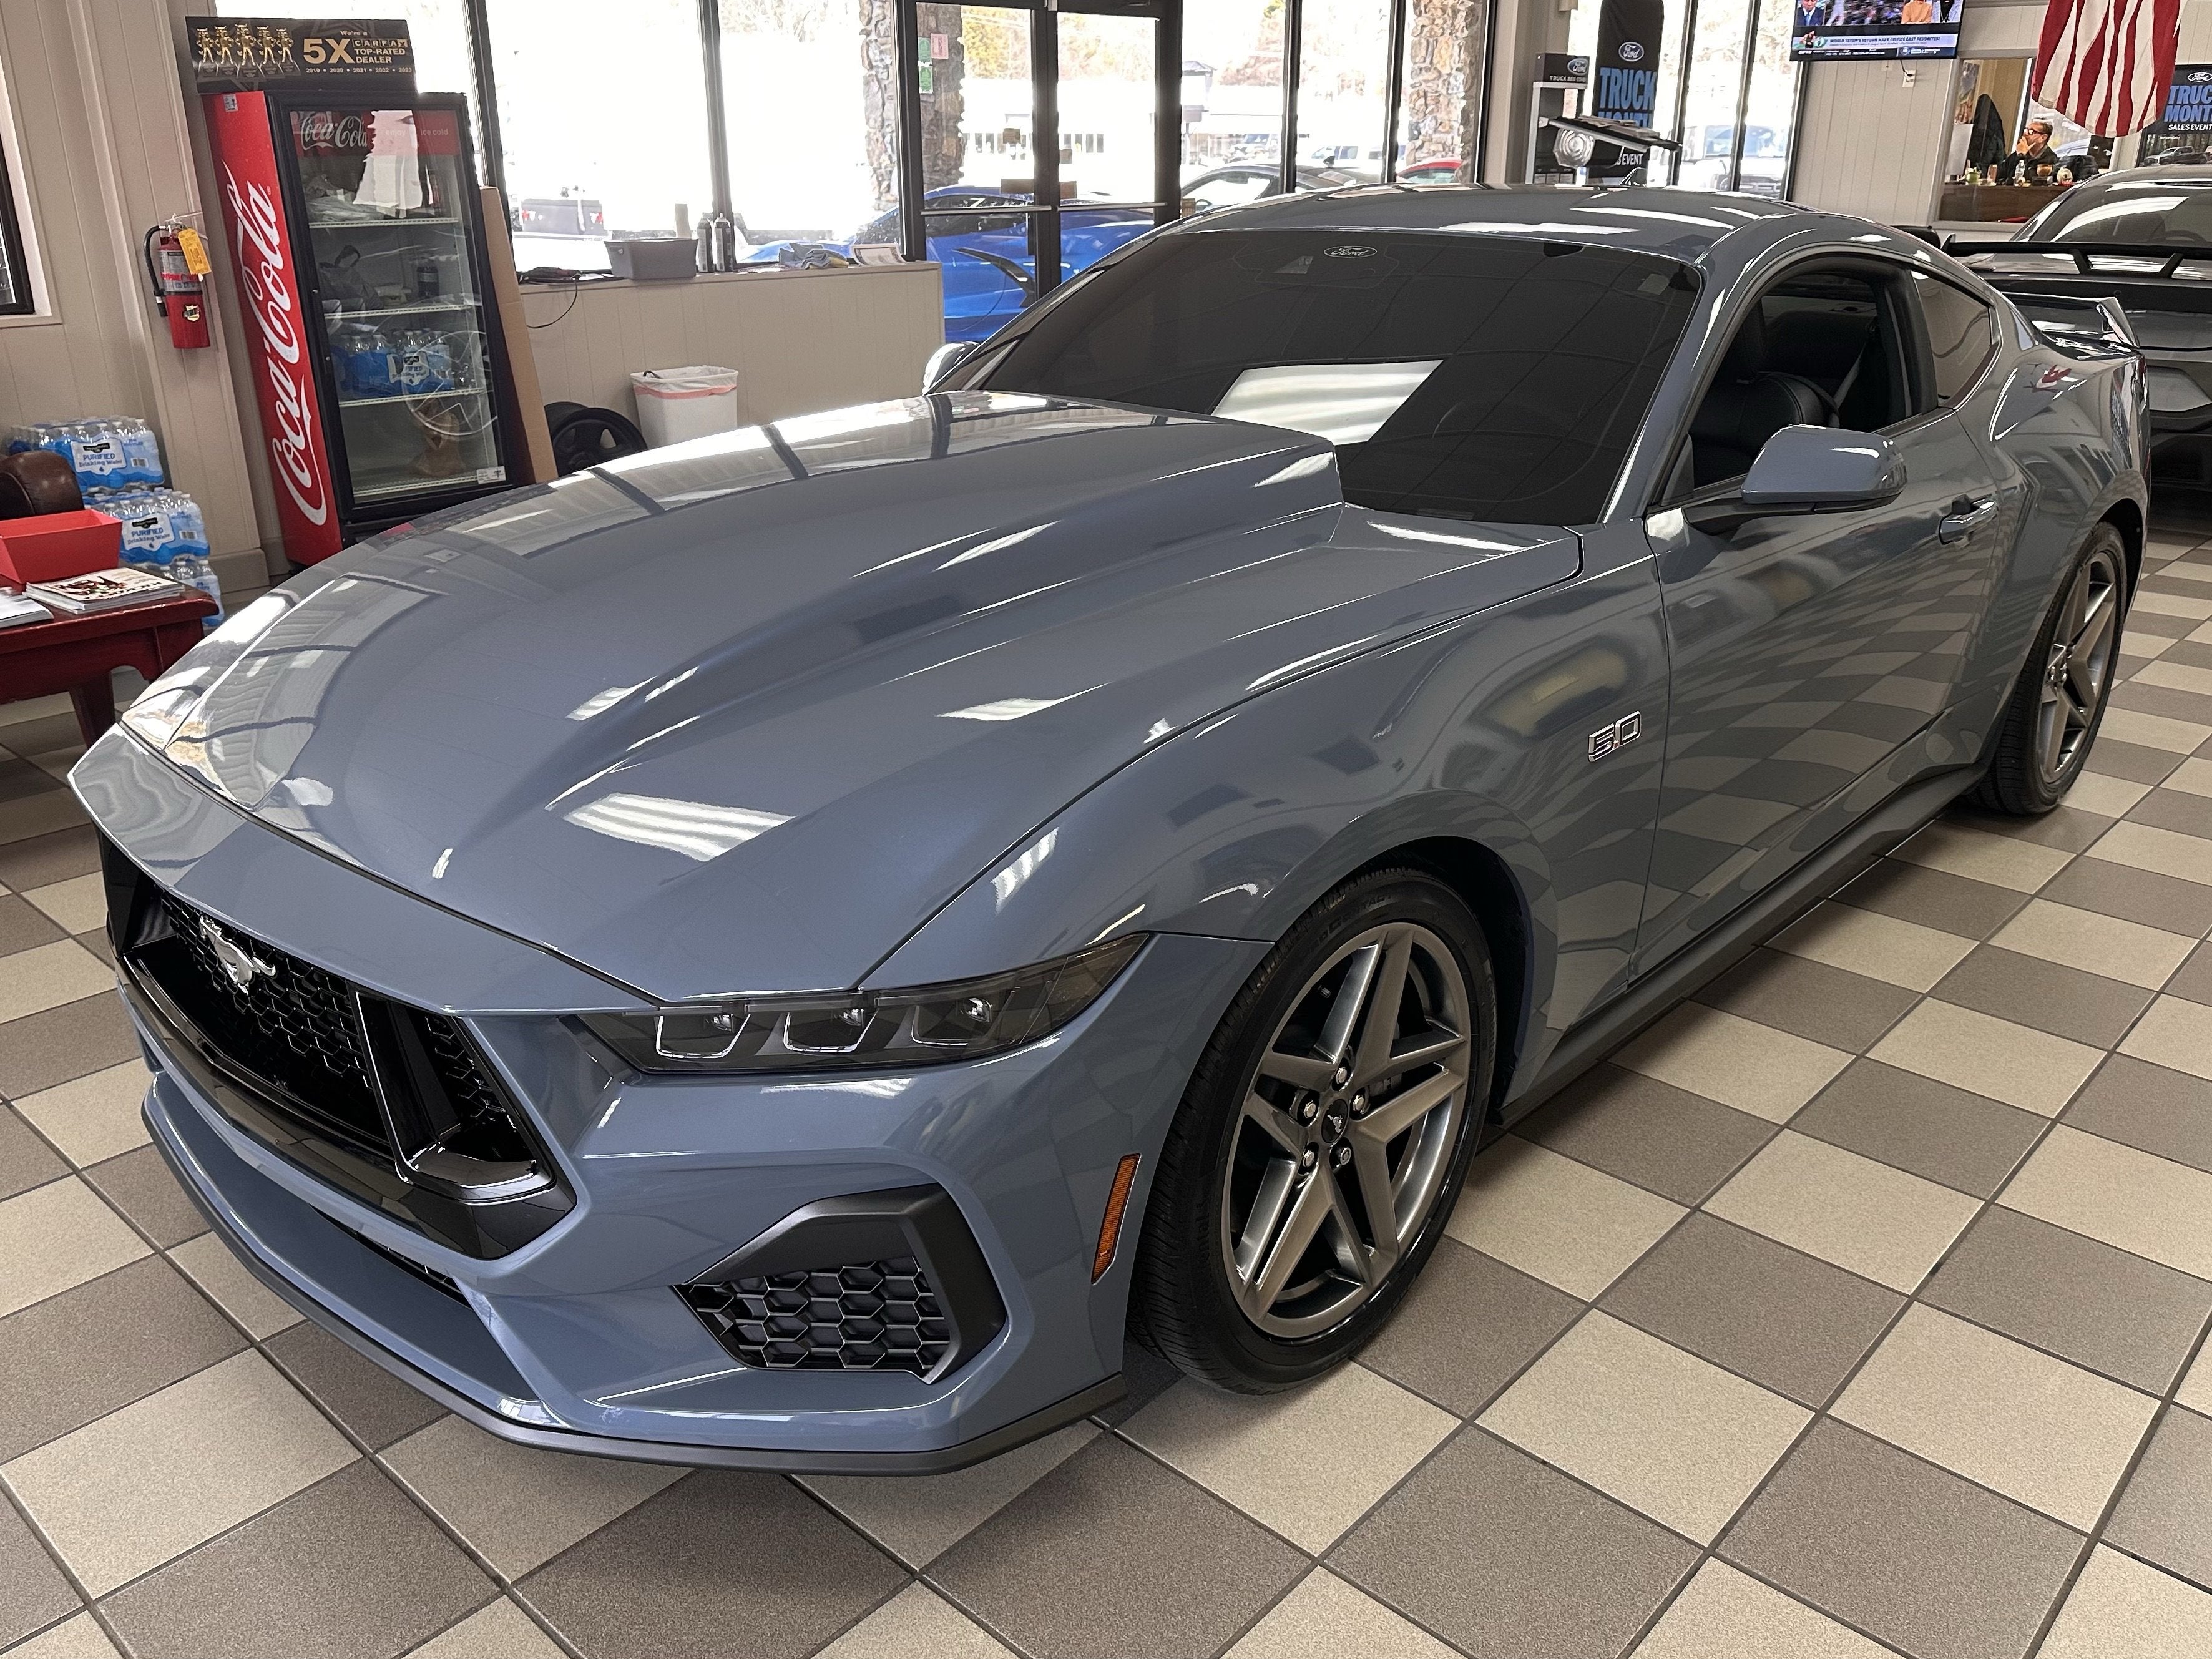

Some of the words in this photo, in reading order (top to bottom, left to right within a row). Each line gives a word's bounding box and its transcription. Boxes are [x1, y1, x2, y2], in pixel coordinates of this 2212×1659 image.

[303, 38, 355, 64] 5X
[353, 39, 408, 47] CARFAX
[1623, 43, 1641, 59] Ford
[2191, 73, 2210, 81] Ford
[1600, 67, 1657, 110] TRUCK
[2168, 85, 2212, 104] TRUC
[2164, 105, 2212, 122] MONT
[301, 115, 368, 150] Coca-Cola
[1622, 154, 1644, 165] EVENT
[1329, 247, 1371, 257] Ford
[222, 159, 327, 526] Coca-Cola
[82, 453, 115, 461] PURIFIED
[131, 527, 164, 537] PURIFIED
[1588, 710, 1642, 763] 5.0
